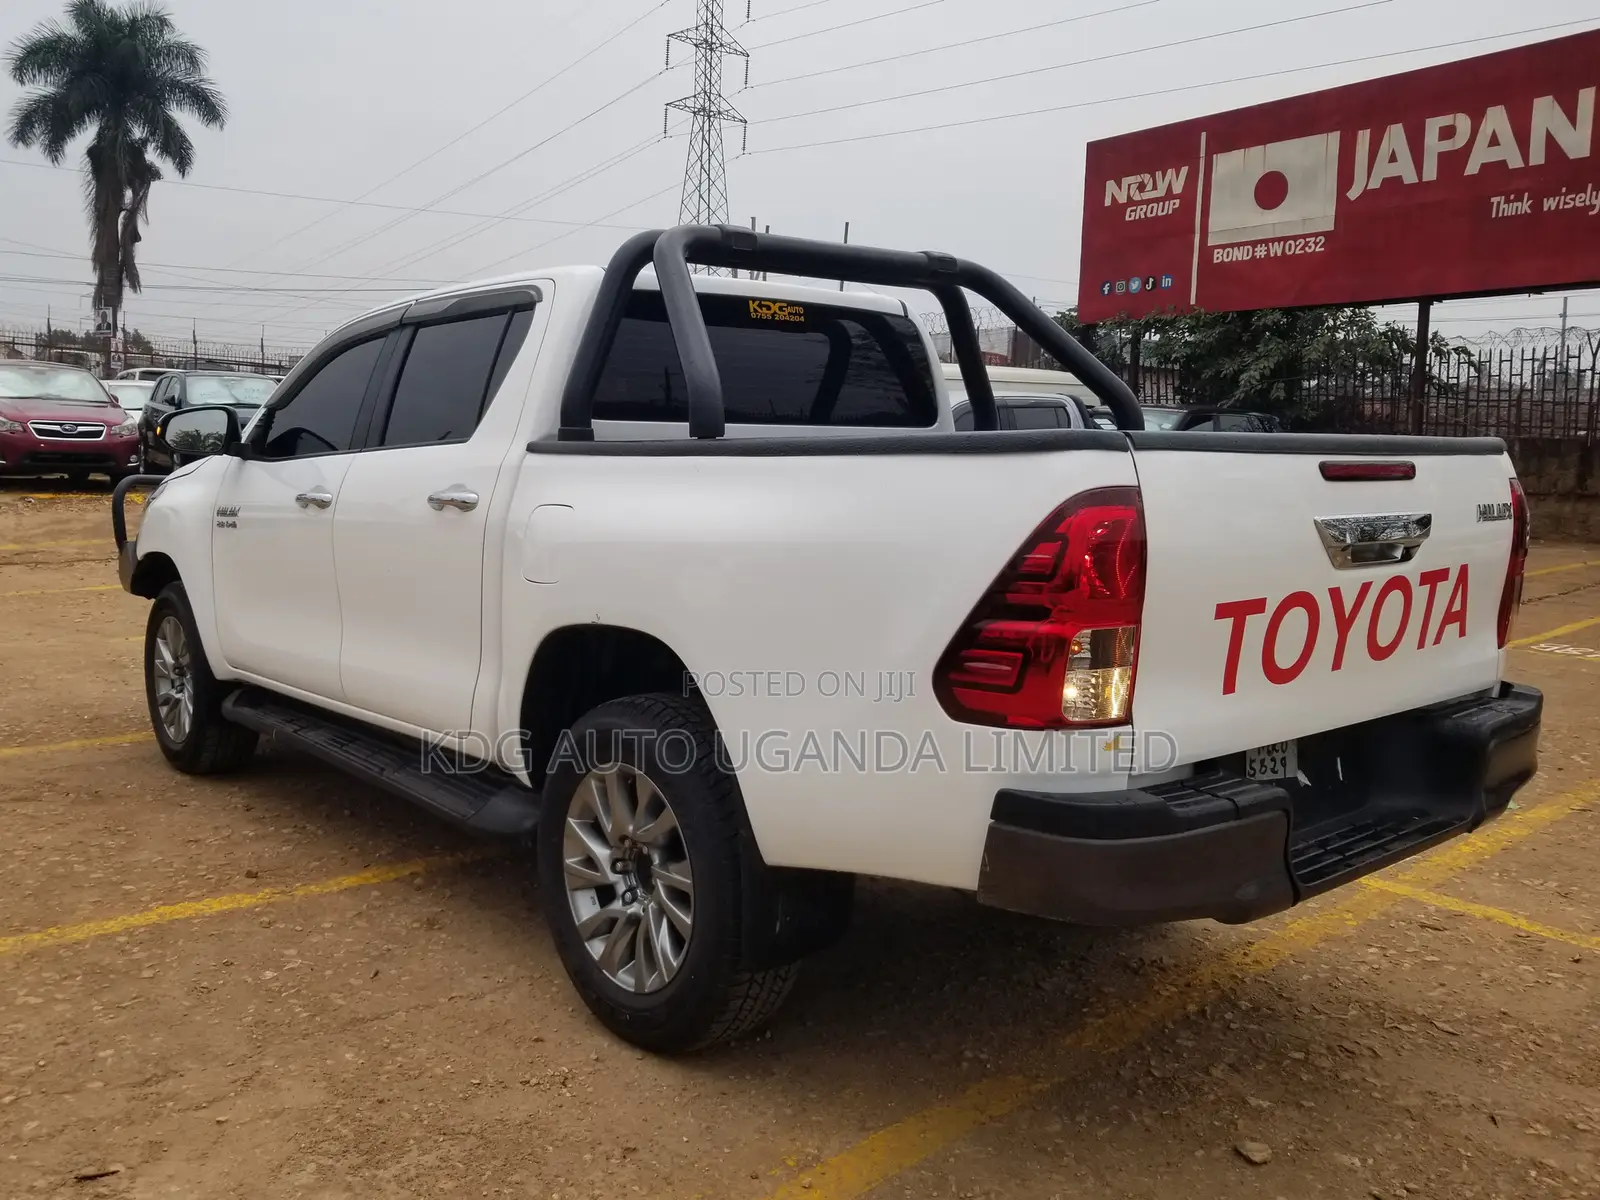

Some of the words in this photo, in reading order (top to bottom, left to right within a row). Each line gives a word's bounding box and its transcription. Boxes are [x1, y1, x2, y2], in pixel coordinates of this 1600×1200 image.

[1346, 86, 1596, 201] JAPAN
[1125, 199, 1180, 221] GROUP
[1490, 192, 1534, 218] Think
[1543, 183, 1600, 216] wisely
[750, 312, 772, 320] 0755
[774, 314, 805, 322] 204204
[1214, 563, 1469, 695] TOYOTA
